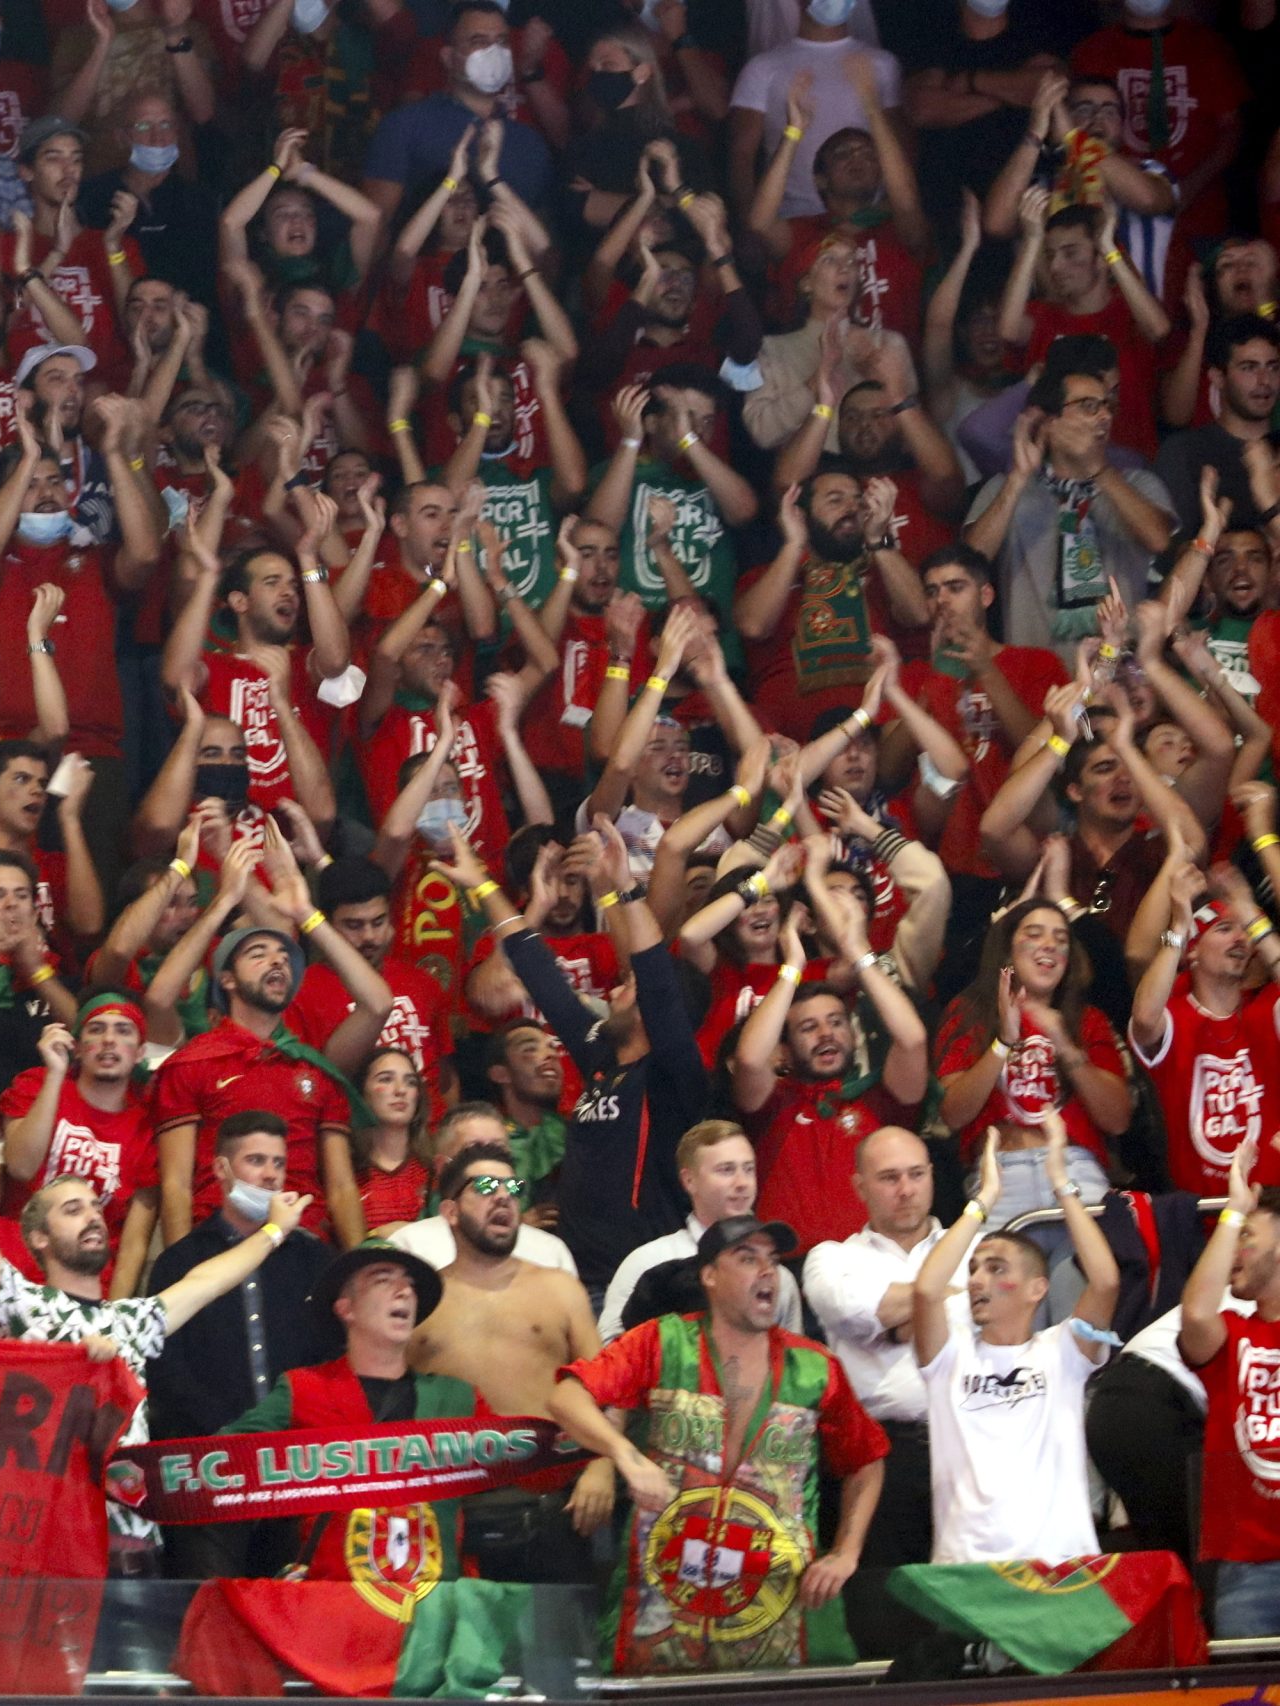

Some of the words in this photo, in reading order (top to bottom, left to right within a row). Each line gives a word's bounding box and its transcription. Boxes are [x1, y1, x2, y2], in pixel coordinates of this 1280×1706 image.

[1009, 1078, 1053, 1099] GAL
[1205, 1089, 1237, 1113] TU
[64, 1154, 93, 1175] TU
[159, 1450, 246, 1492] F.C.
[256, 1429, 538, 1486] LUSITANOS
